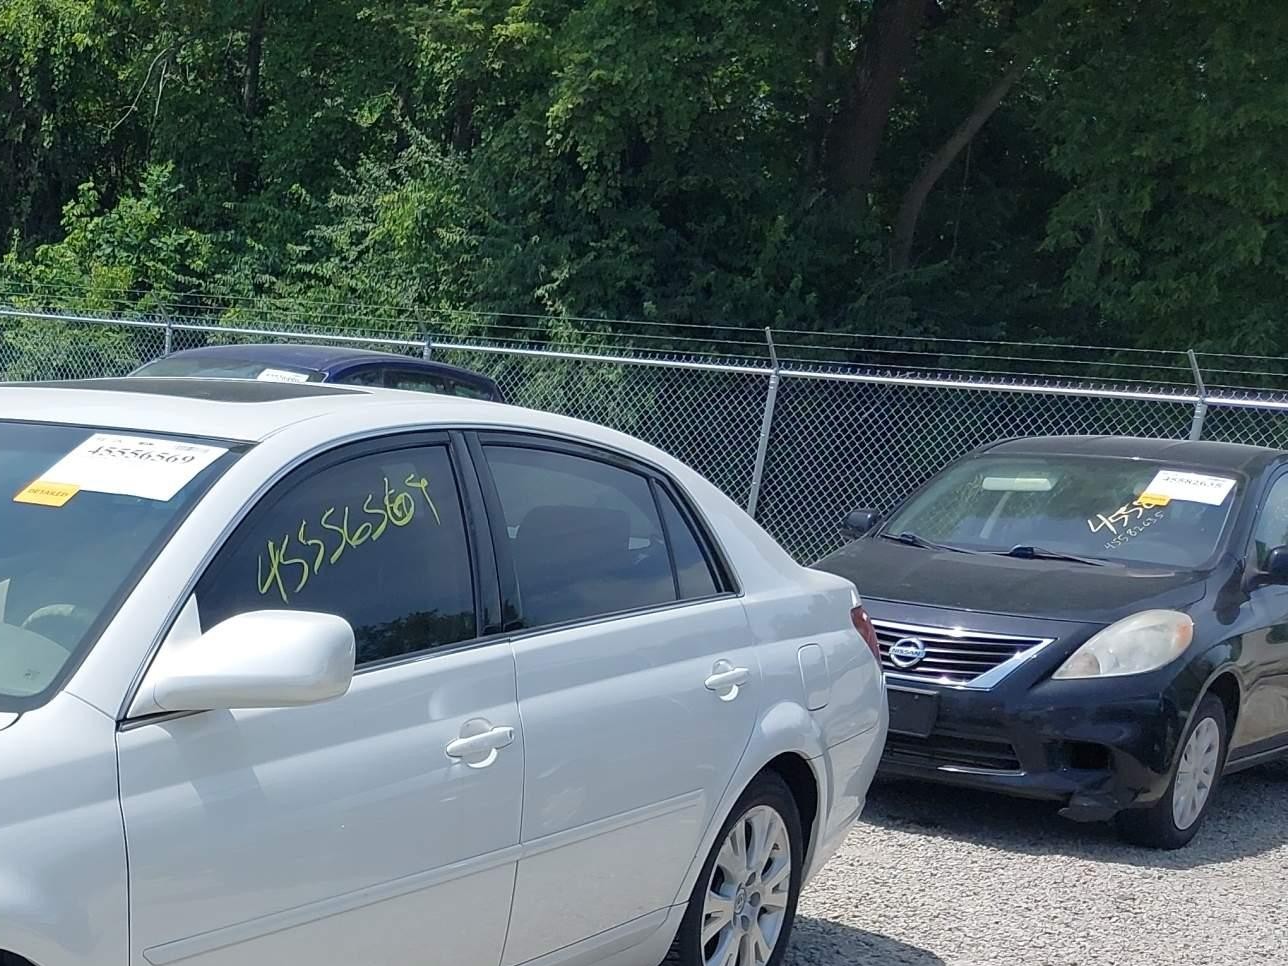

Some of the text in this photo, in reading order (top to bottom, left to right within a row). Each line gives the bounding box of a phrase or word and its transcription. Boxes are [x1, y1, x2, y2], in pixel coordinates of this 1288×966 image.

[87, 445, 196, 464] 45556569
[257, 473, 441, 604] 45556569
[892, 648, 922, 657] NISSAN
